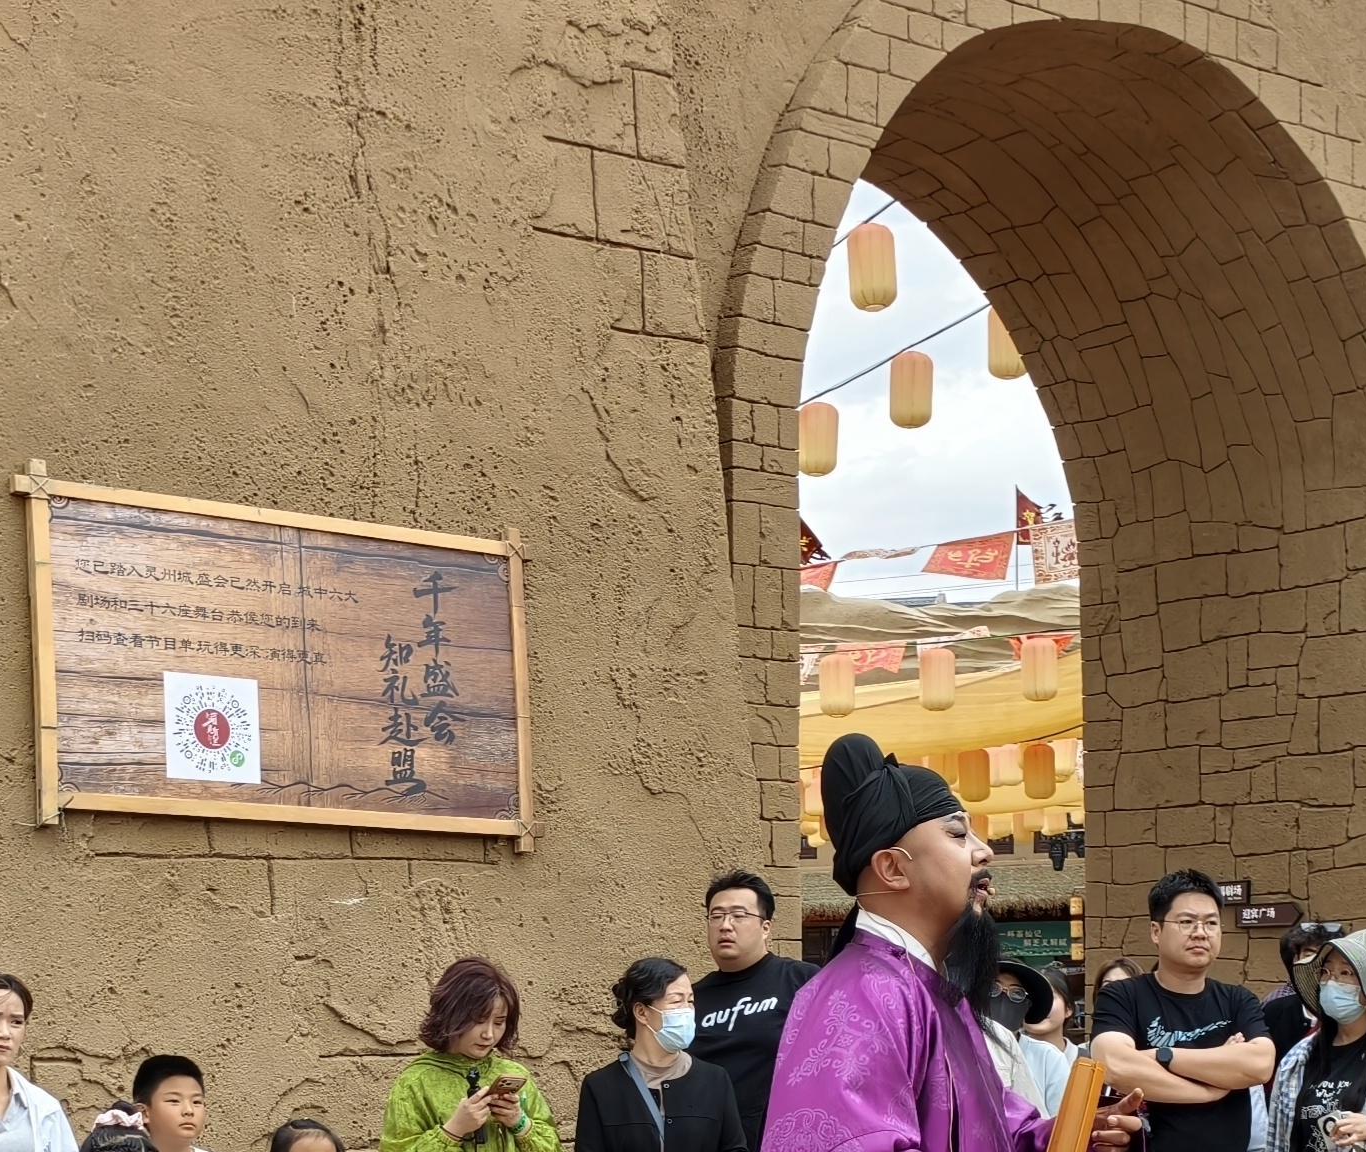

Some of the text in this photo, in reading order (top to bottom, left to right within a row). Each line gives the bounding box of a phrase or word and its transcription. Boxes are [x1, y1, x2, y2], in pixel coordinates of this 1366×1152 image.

[376, 633, 428, 797] 知礼赴盟
[413, 570, 468, 746] 千年盛会
[701, 996, 778, 1031] aufum
